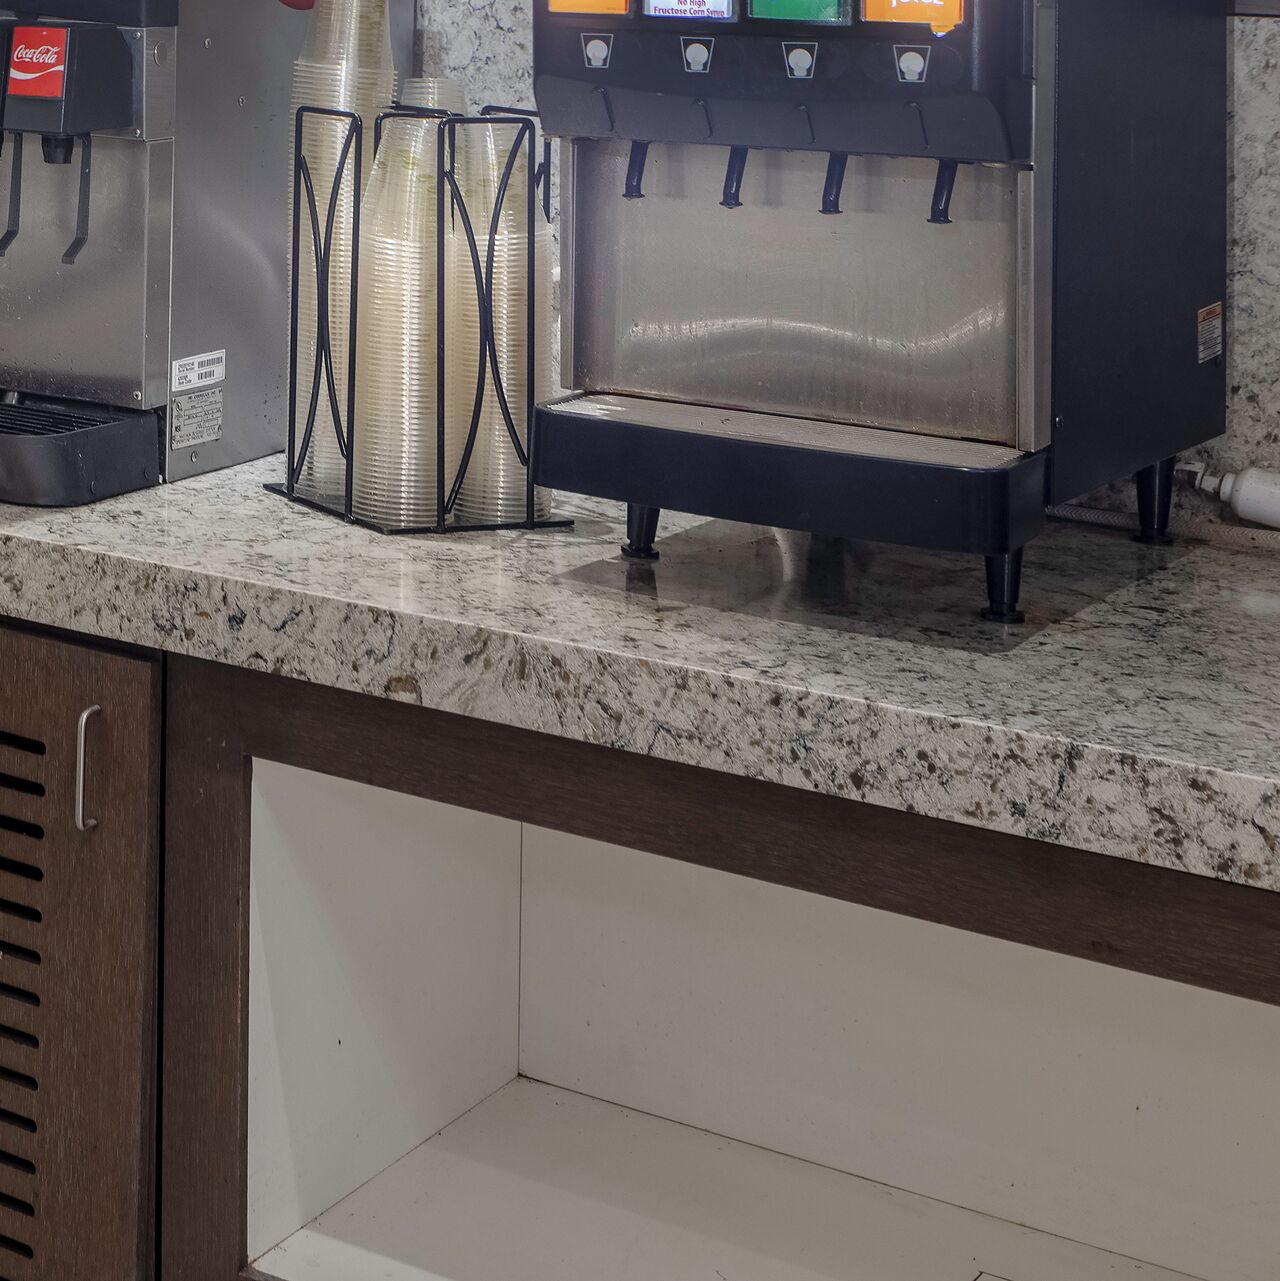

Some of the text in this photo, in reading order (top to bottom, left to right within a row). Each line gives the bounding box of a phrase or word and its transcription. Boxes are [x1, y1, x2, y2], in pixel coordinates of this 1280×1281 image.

[654, 6, 687, 15] Fructose
[689, 7, 705, 16] Corn
[13, 44, 61, 63] Coca-Cola
